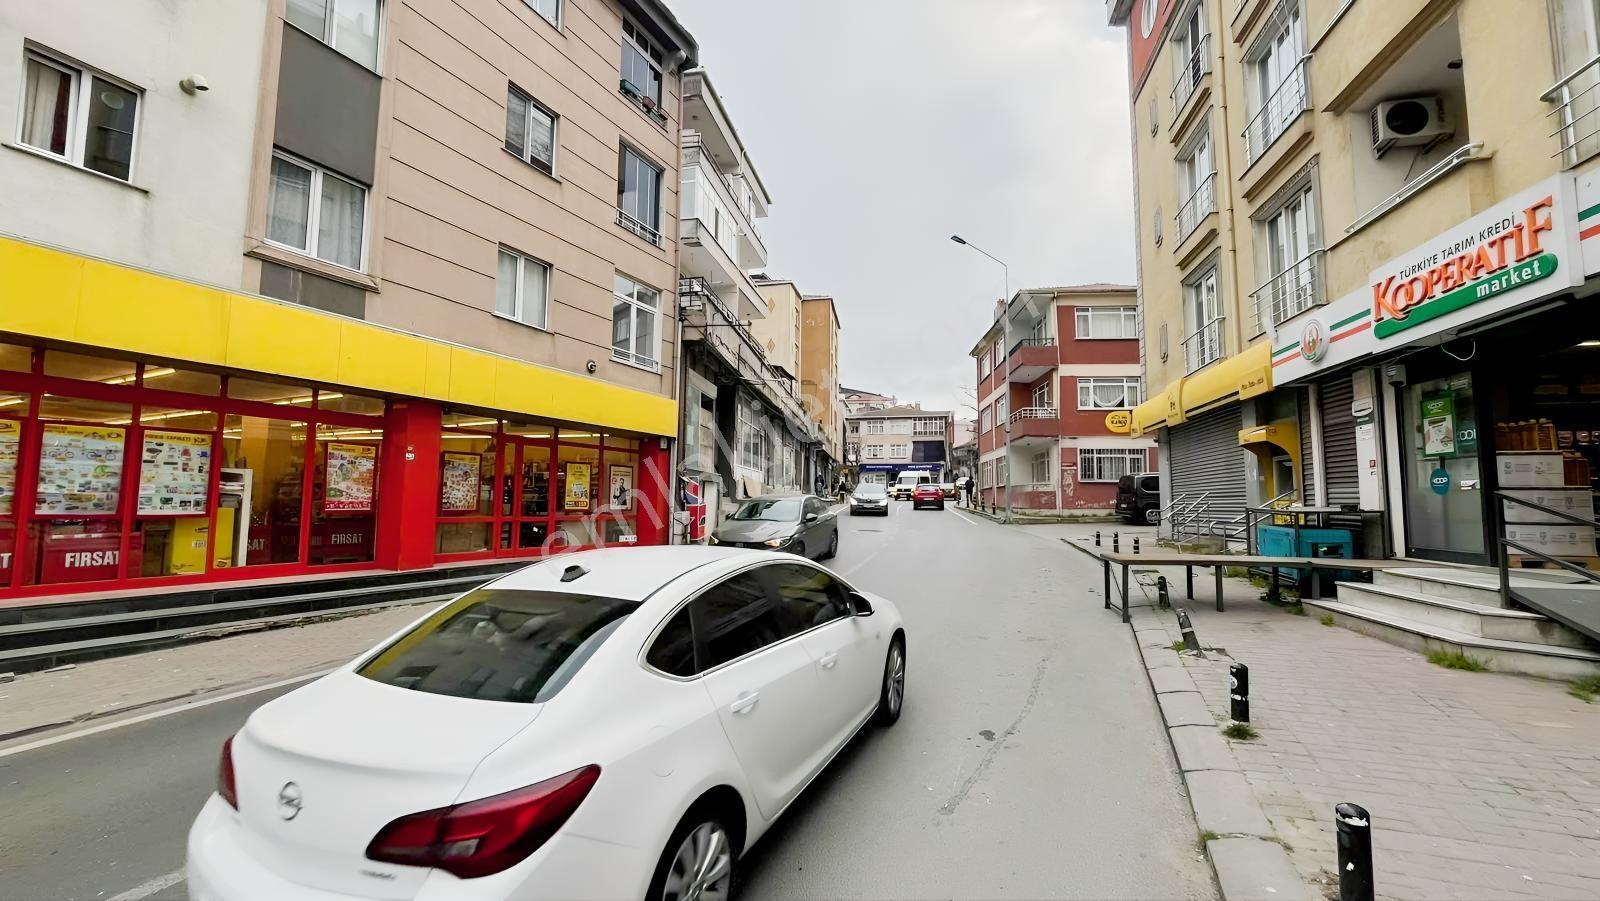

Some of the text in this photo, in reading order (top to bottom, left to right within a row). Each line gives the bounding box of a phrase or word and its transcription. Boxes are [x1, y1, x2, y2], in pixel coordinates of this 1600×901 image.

[1398, 208, 1518, 281] TÜRKİYE TARIM KREDİ
[1475, 258, 1542, 298] market
[331, 533, 364, 545] FIRSAT
[64, 550, 119, 568] FIRSAT
